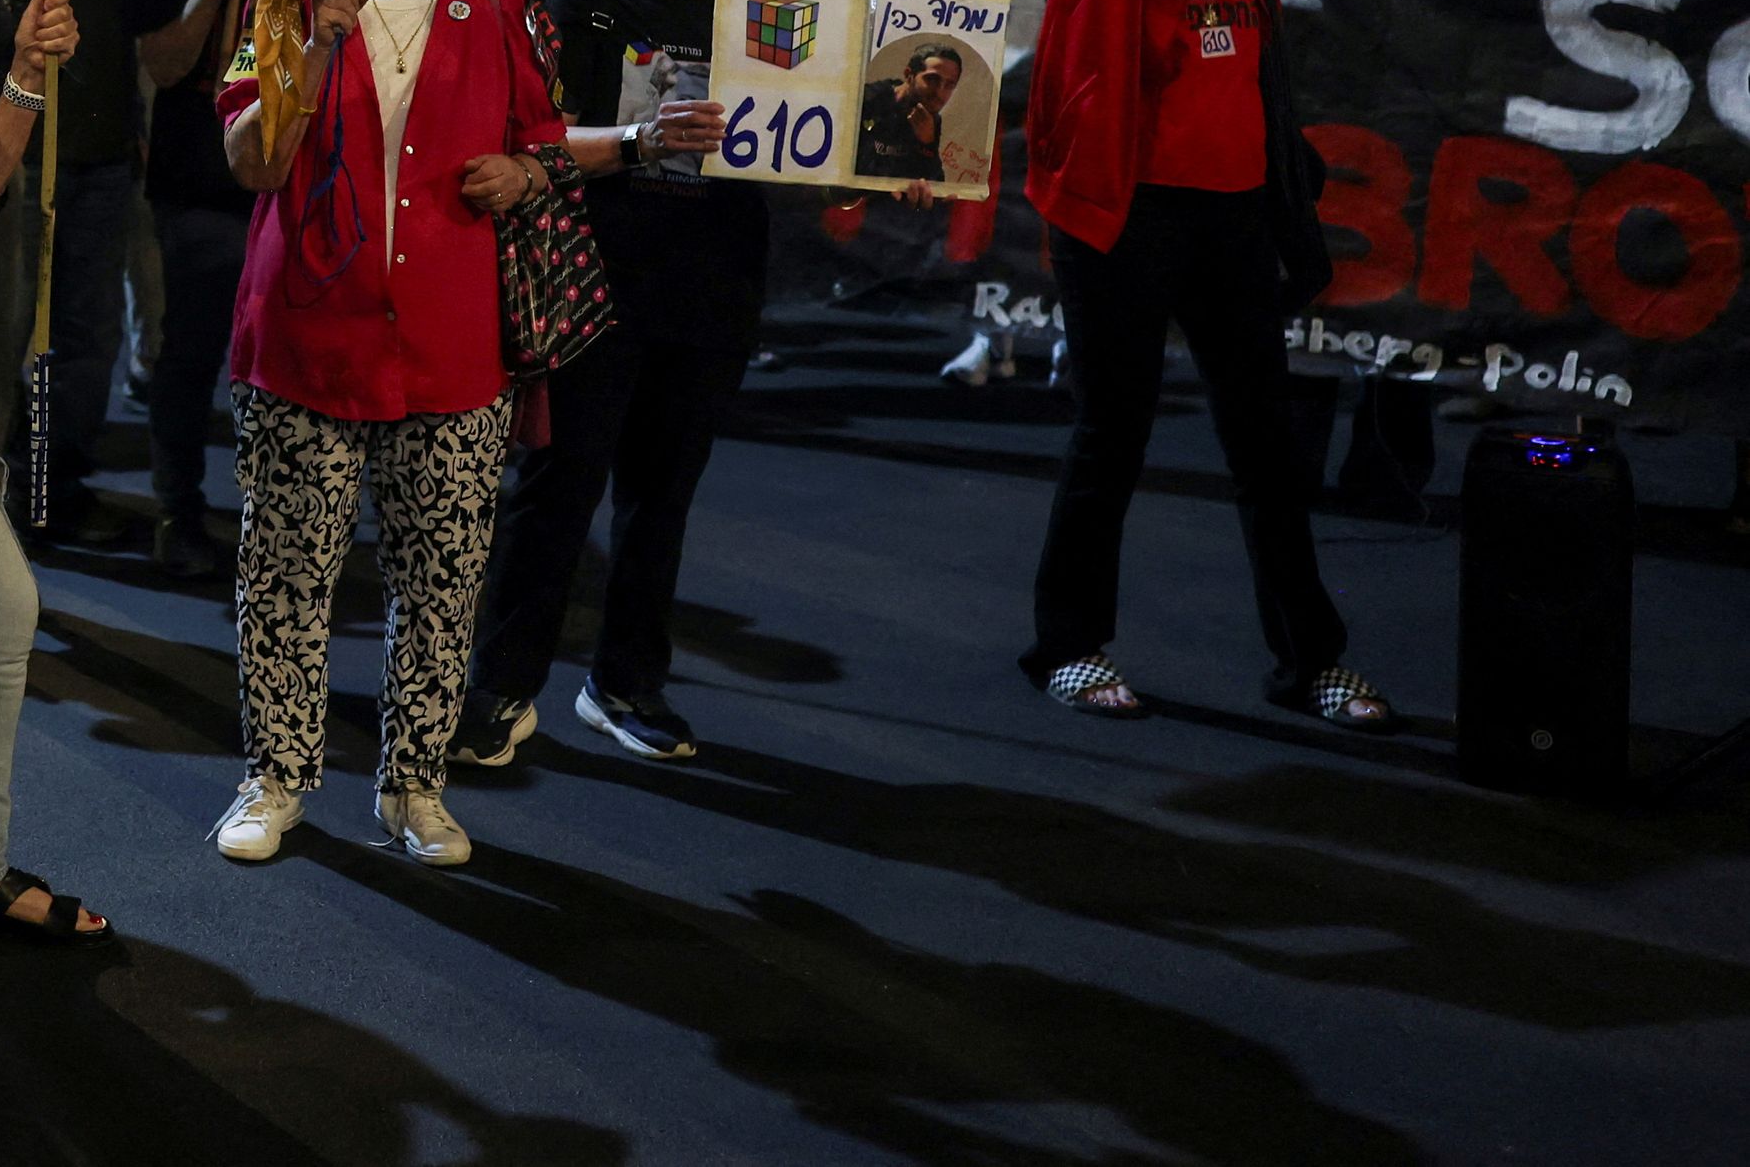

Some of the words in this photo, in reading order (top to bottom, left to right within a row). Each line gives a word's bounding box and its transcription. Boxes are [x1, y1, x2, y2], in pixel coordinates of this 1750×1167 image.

[876, 1, 923, 48] כהן
[1202, 29, 1231, 54] 610
[721, 95, 834, 173] 610
[1302, 122, 1750, 343] BRO
